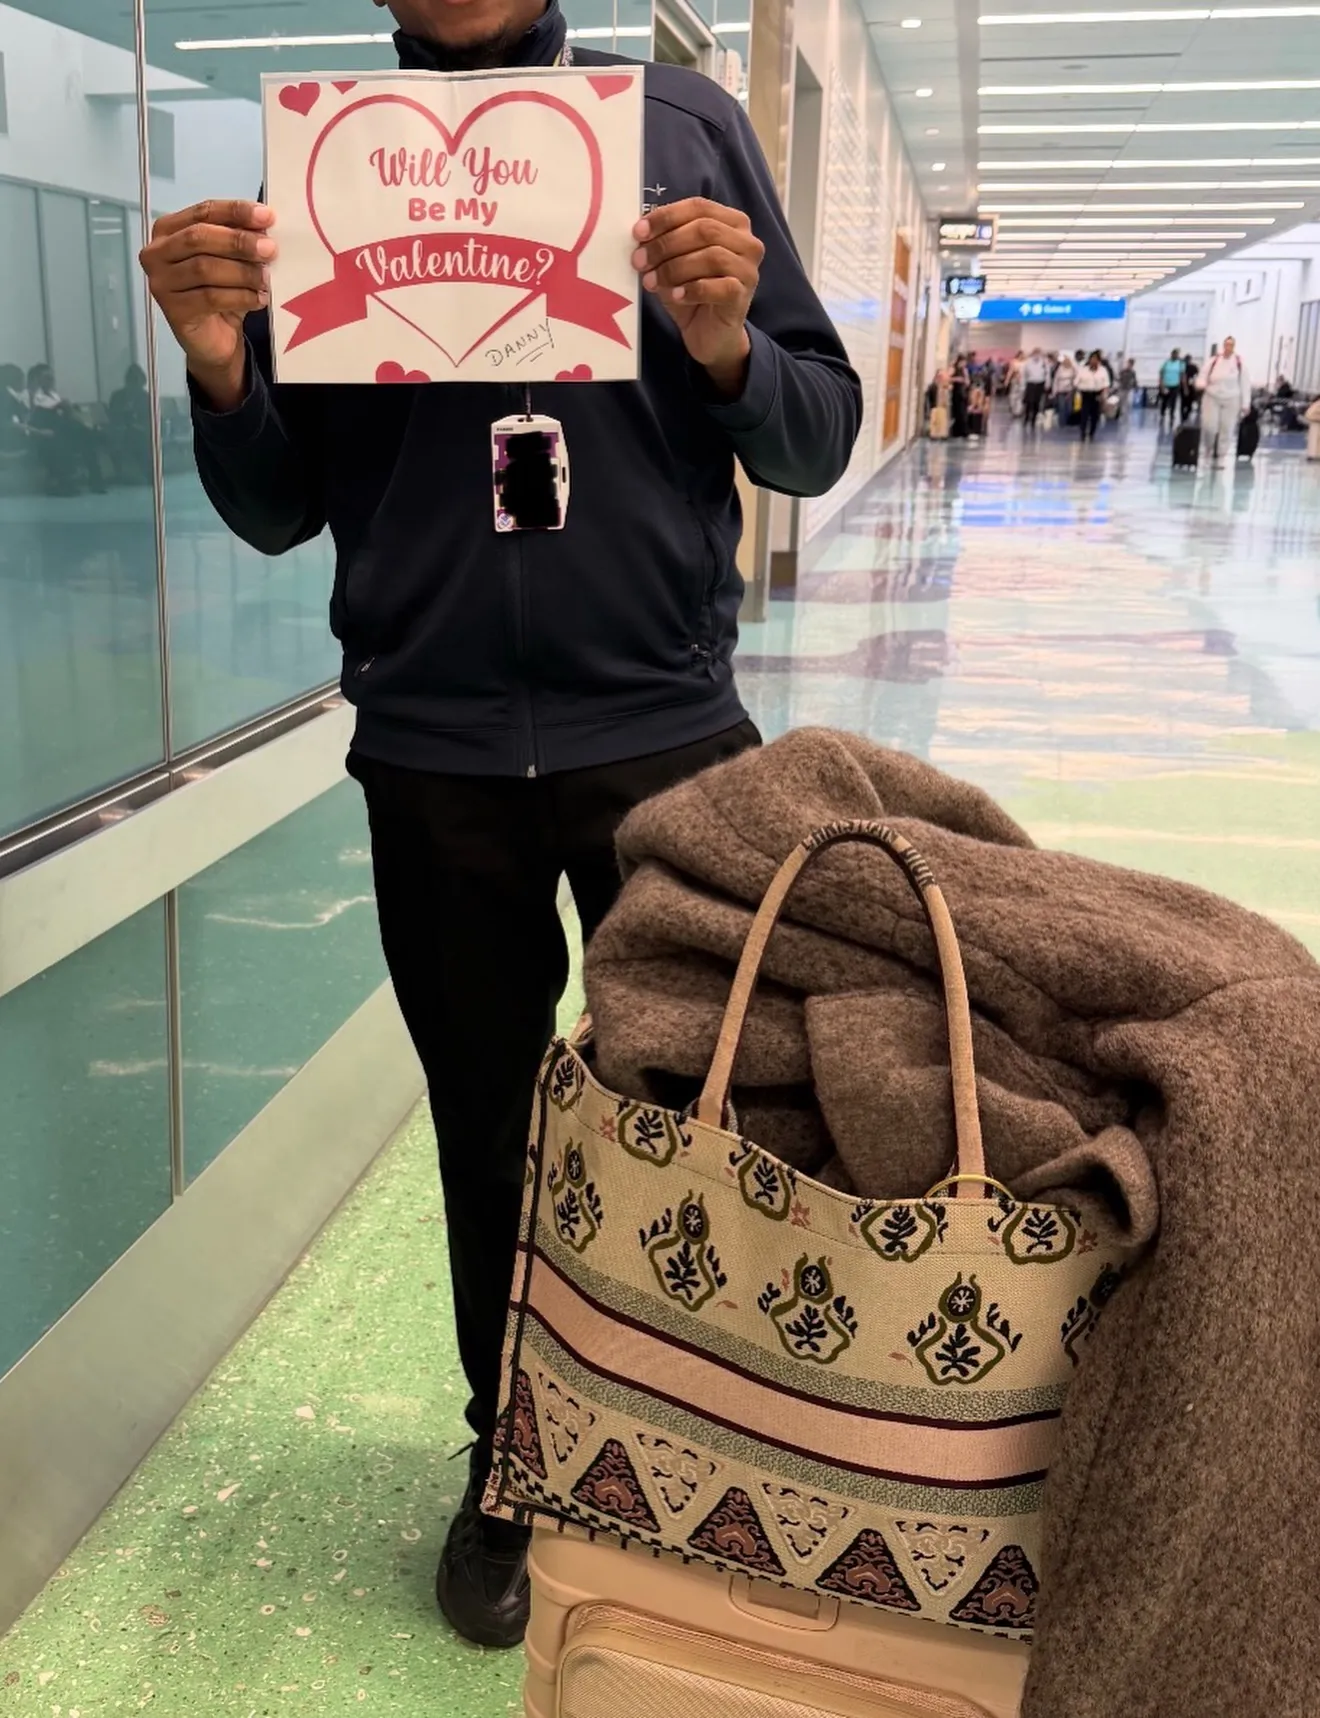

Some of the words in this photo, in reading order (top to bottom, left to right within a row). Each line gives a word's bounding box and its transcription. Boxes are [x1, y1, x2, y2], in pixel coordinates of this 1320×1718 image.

[369, 147, 452, 187] Will
[462, 147, 539, 196] You
[408, 198, 446, 221] Be
[455, 198, 499, 227] My
[355, 237, 555, 286] Valentine?
[485, 318, 555, 367] DANNY
